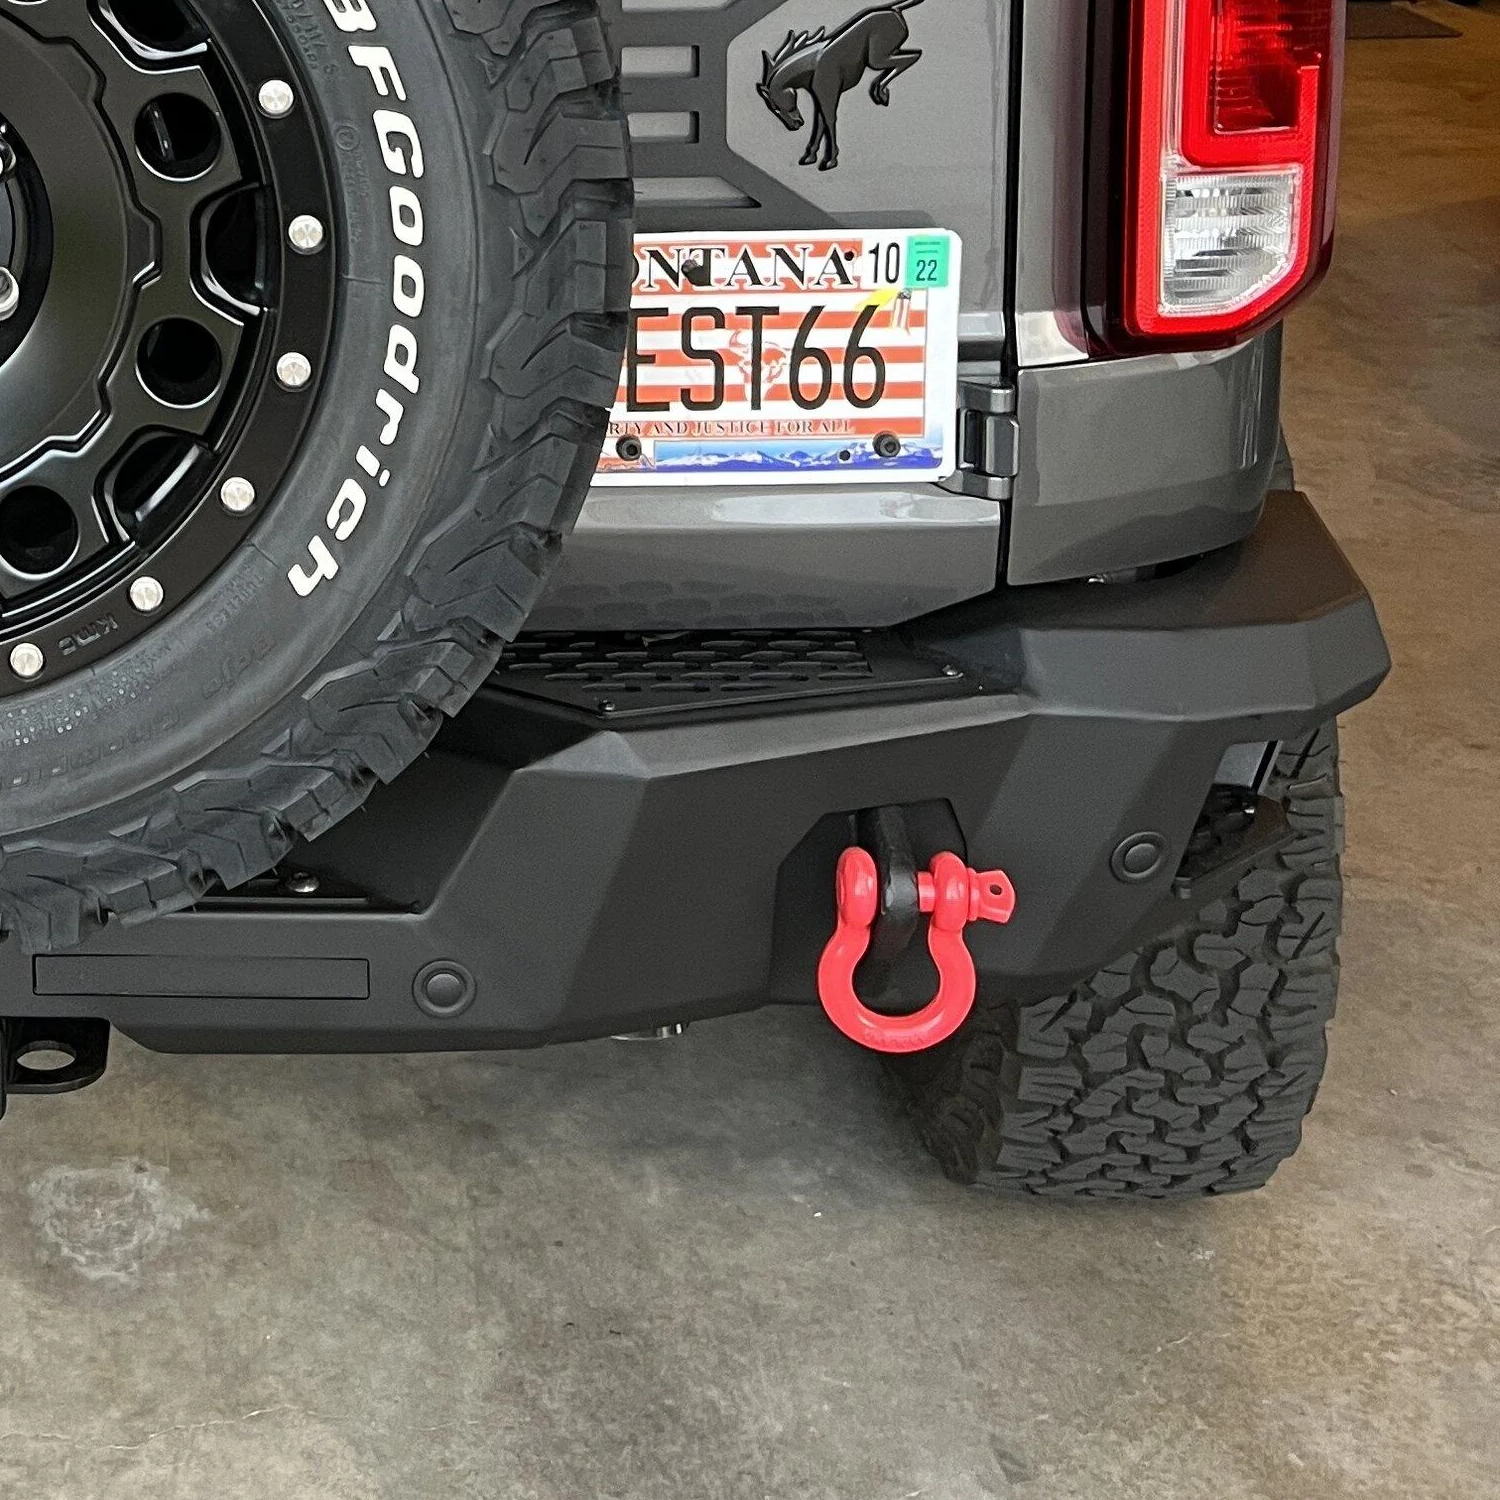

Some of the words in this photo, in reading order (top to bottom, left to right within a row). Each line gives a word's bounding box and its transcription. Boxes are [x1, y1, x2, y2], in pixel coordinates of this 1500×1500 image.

[869, 242, 900, 284] 10
[915, 259, 937, 282] 22
[626, 305, 887, 412] EST66
[652, 422, 688, 434] AND
